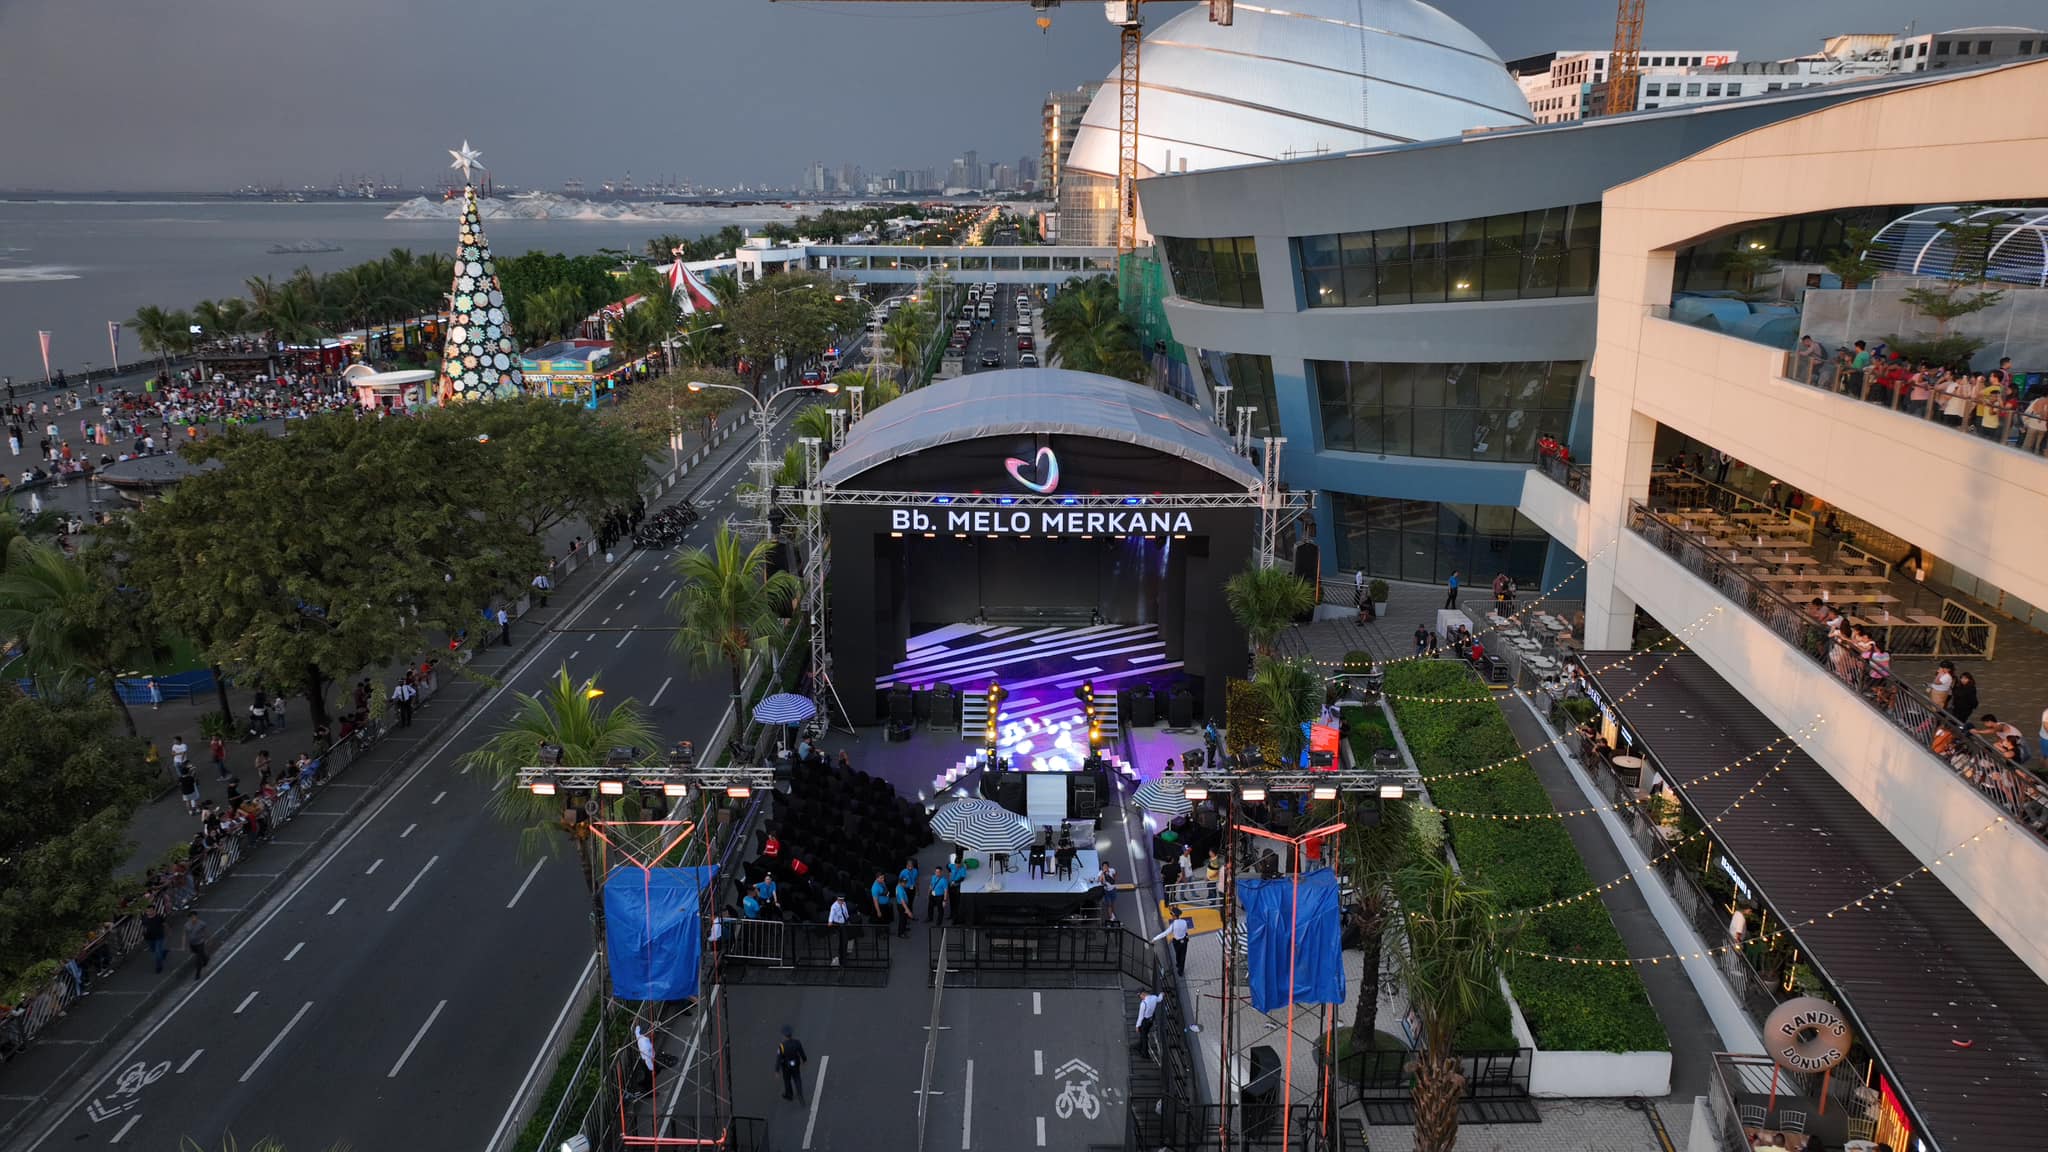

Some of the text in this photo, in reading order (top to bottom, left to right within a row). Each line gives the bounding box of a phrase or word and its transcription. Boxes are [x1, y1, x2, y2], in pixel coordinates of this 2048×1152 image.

[892, 509, 1193, 533] Bb. MELO MERKANA
[1780, 1011, 1846, 1037] RANDY'S
[1782, 1047, 1841, 1070] DONUTS
